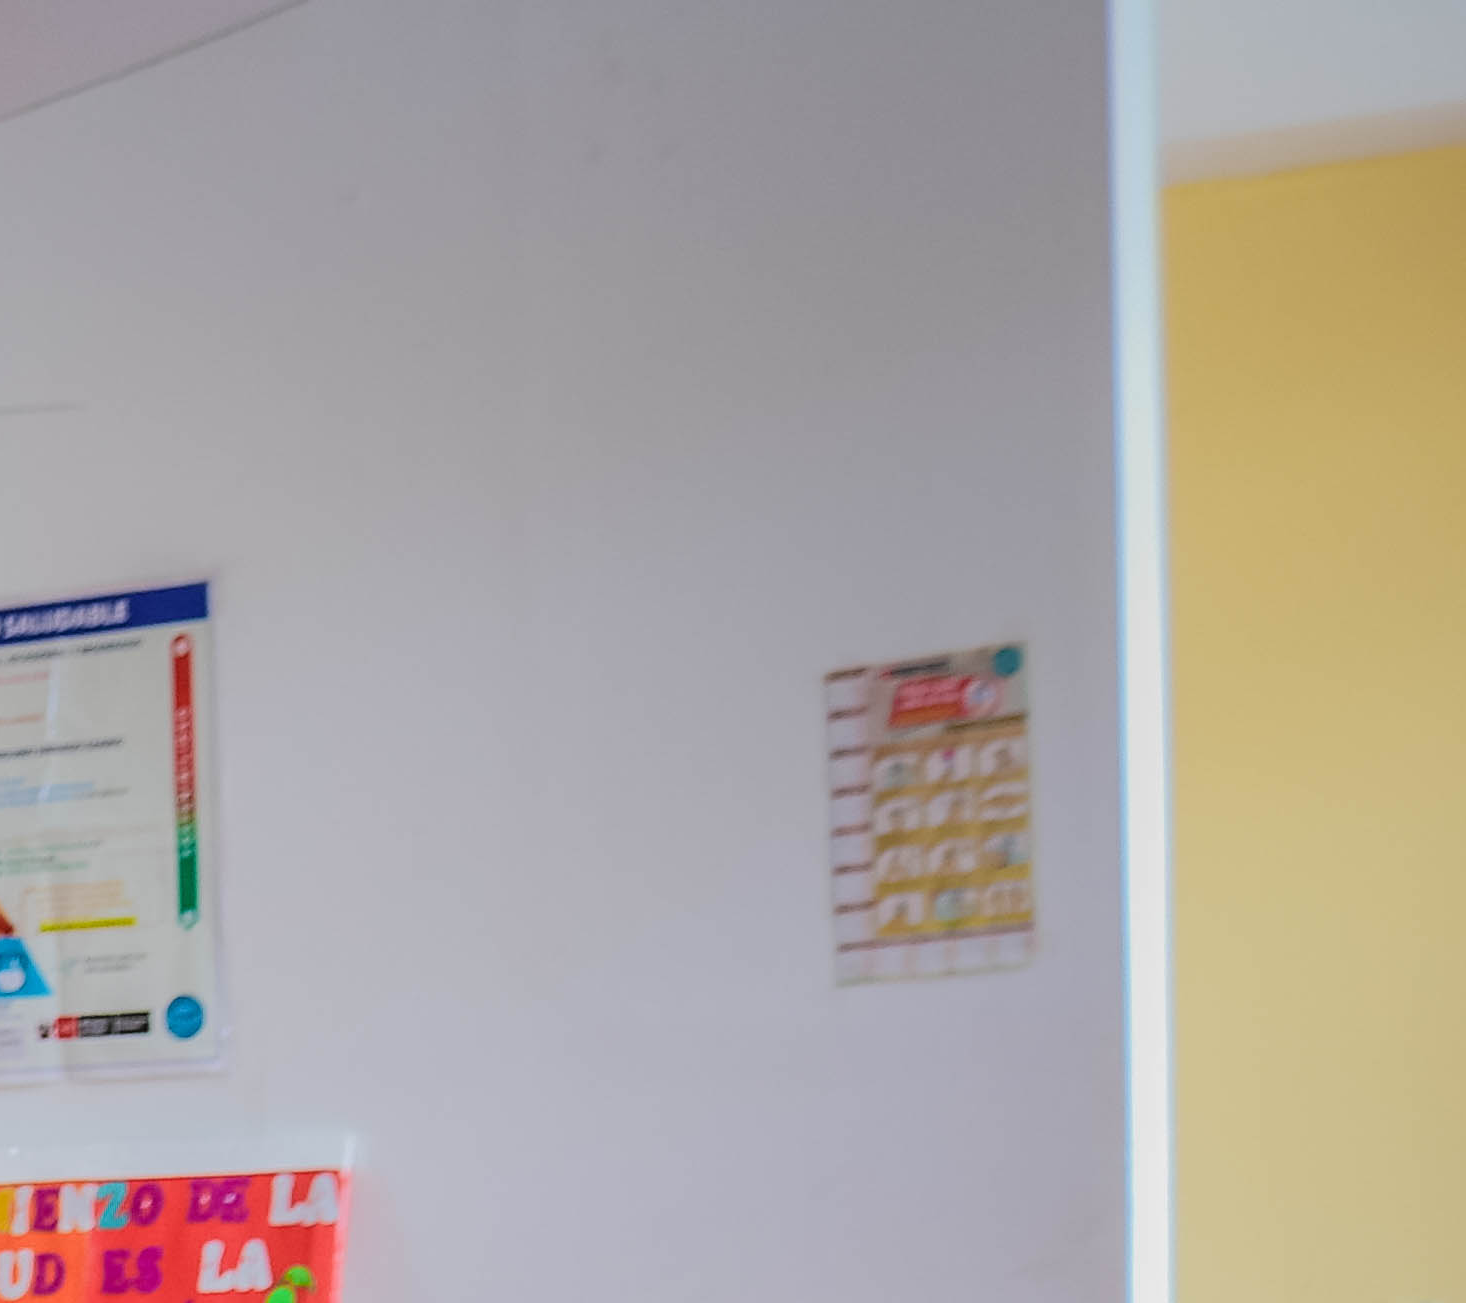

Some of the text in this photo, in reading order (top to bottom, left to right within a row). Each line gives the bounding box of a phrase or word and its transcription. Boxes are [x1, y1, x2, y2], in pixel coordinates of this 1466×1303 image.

[186, 1176, 251, 1224] DE
[268, 1173, 339, 1226] LA
[100, 1246, 164, 1294] ES
[198, 1238, 272, 1293] LA
